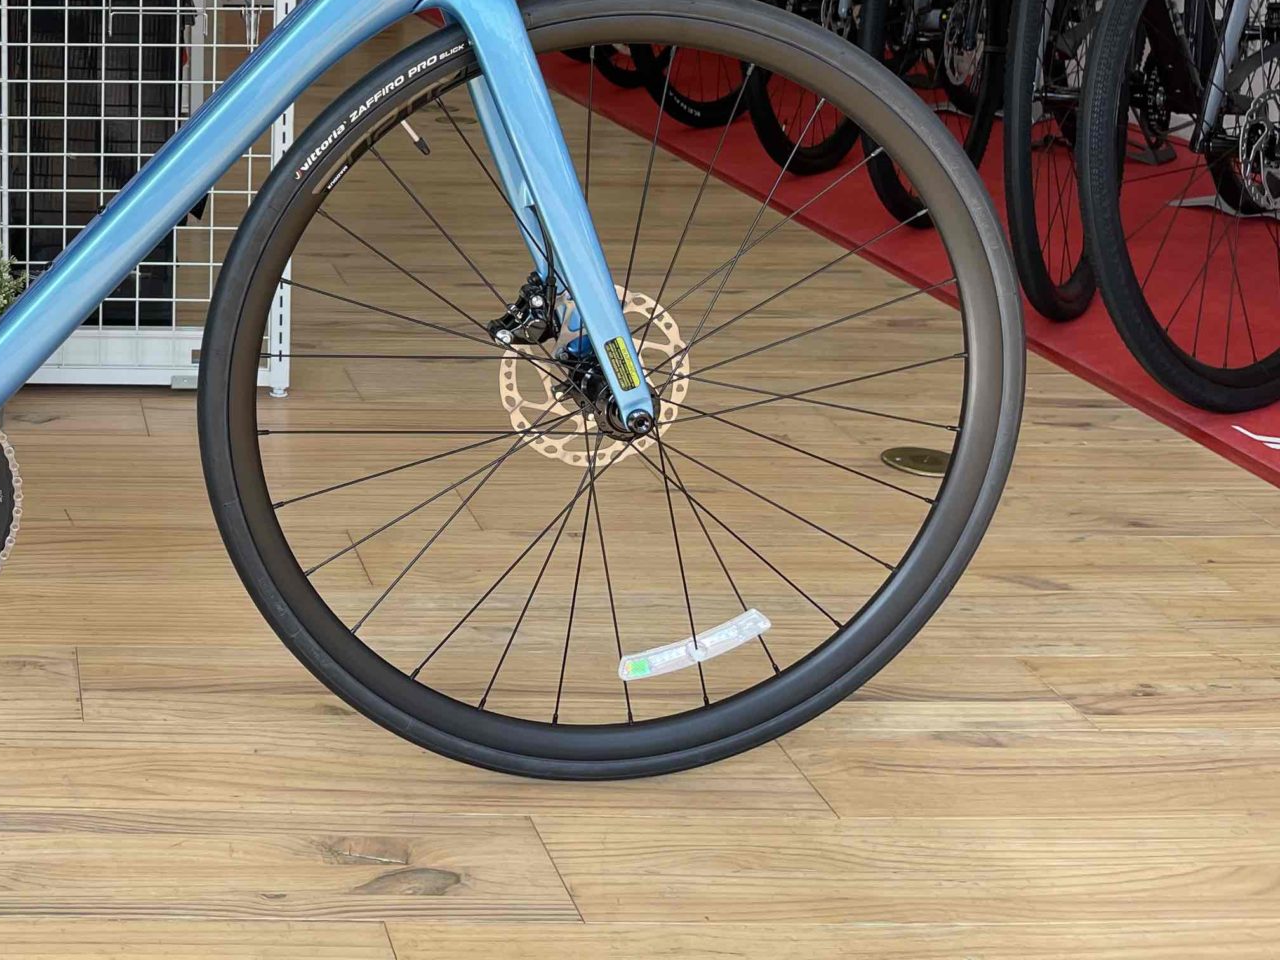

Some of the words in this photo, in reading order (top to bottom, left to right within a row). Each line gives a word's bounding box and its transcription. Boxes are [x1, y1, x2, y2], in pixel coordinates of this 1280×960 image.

[349, 75, 405, 123] ZAFFIRO
[408, 54, 438, 78] PRO
[439, 43, 465, 60] SLICK
